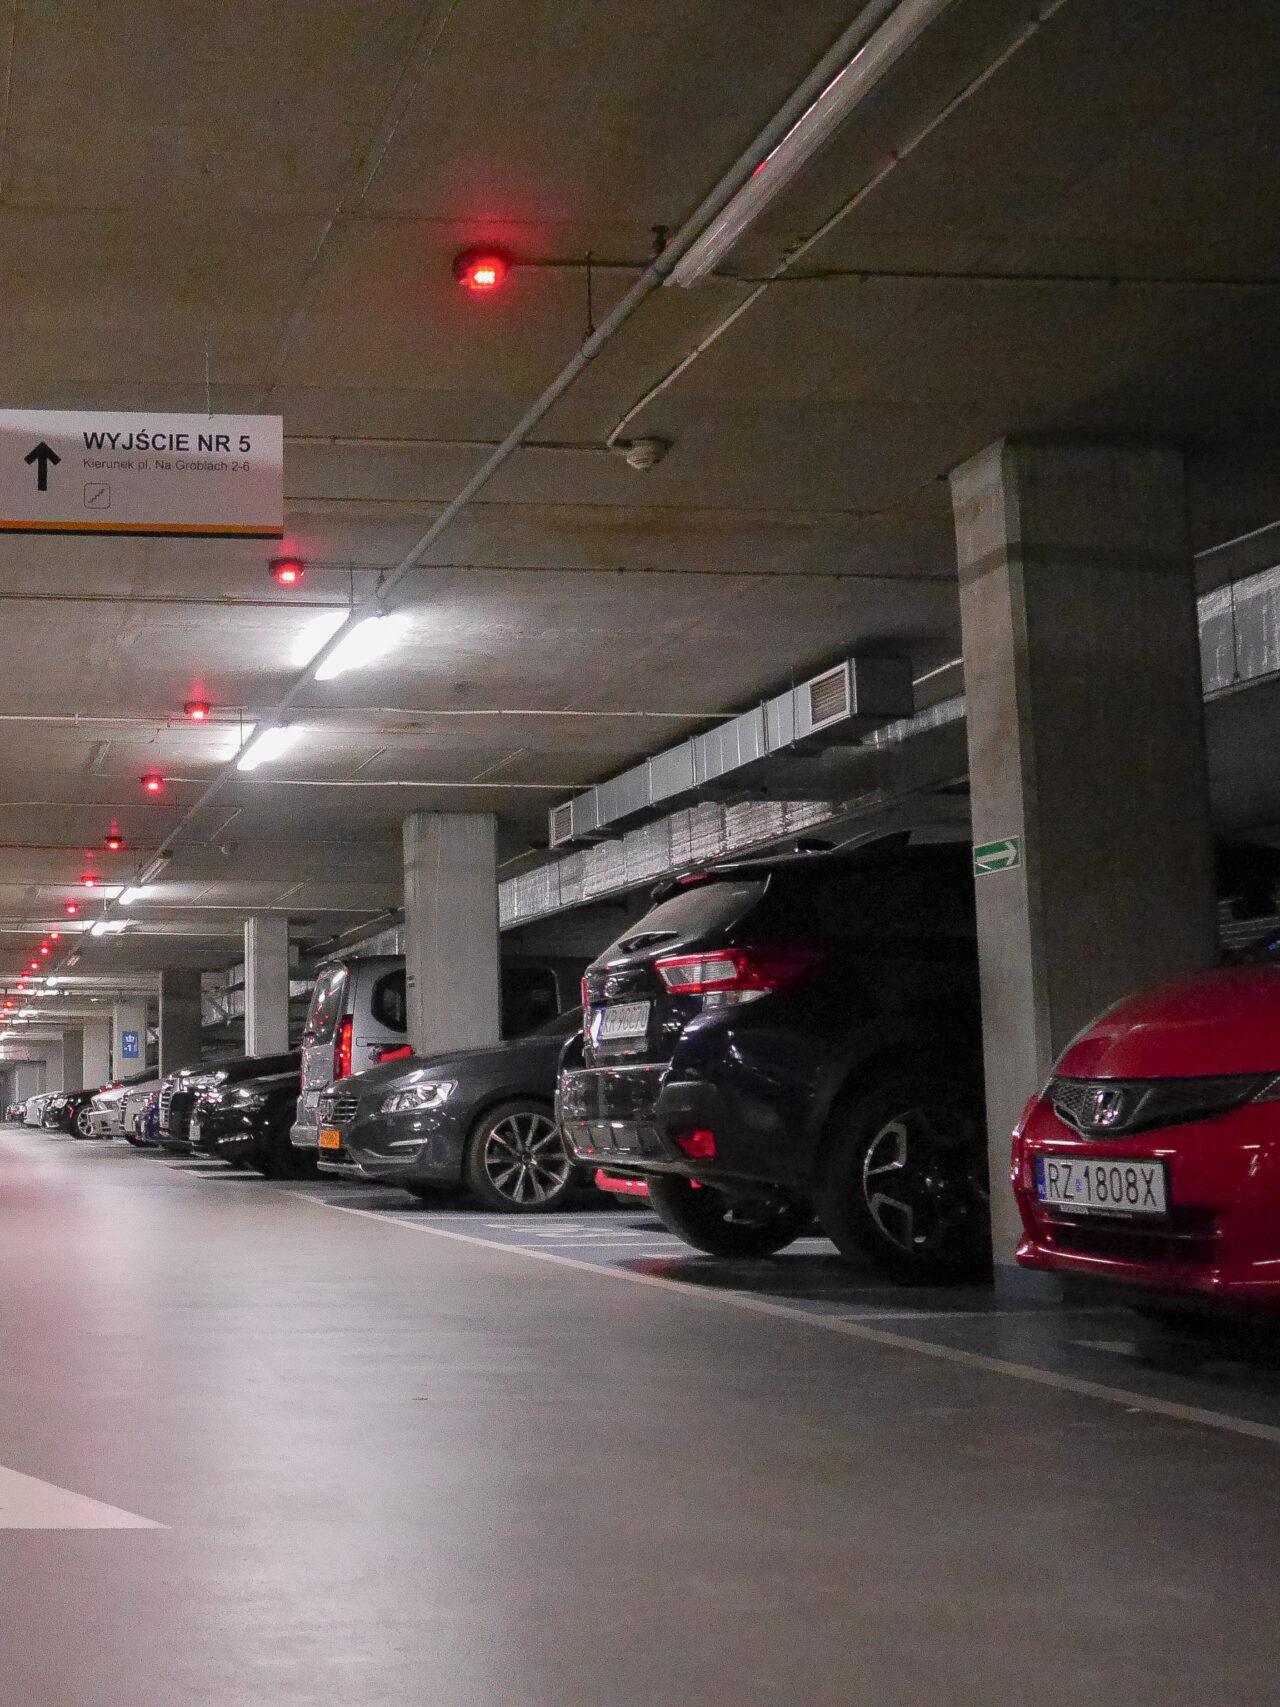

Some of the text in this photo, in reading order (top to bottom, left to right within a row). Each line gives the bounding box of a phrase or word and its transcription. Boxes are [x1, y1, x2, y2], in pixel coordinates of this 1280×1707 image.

[82, 428, 251, 453] WYJŚCIE NR 5
[82, 458, 250, 472] Kierunek pl. Na Groblach 2-6
[1048, 1162, 1157, 1207] RZ 1808X
